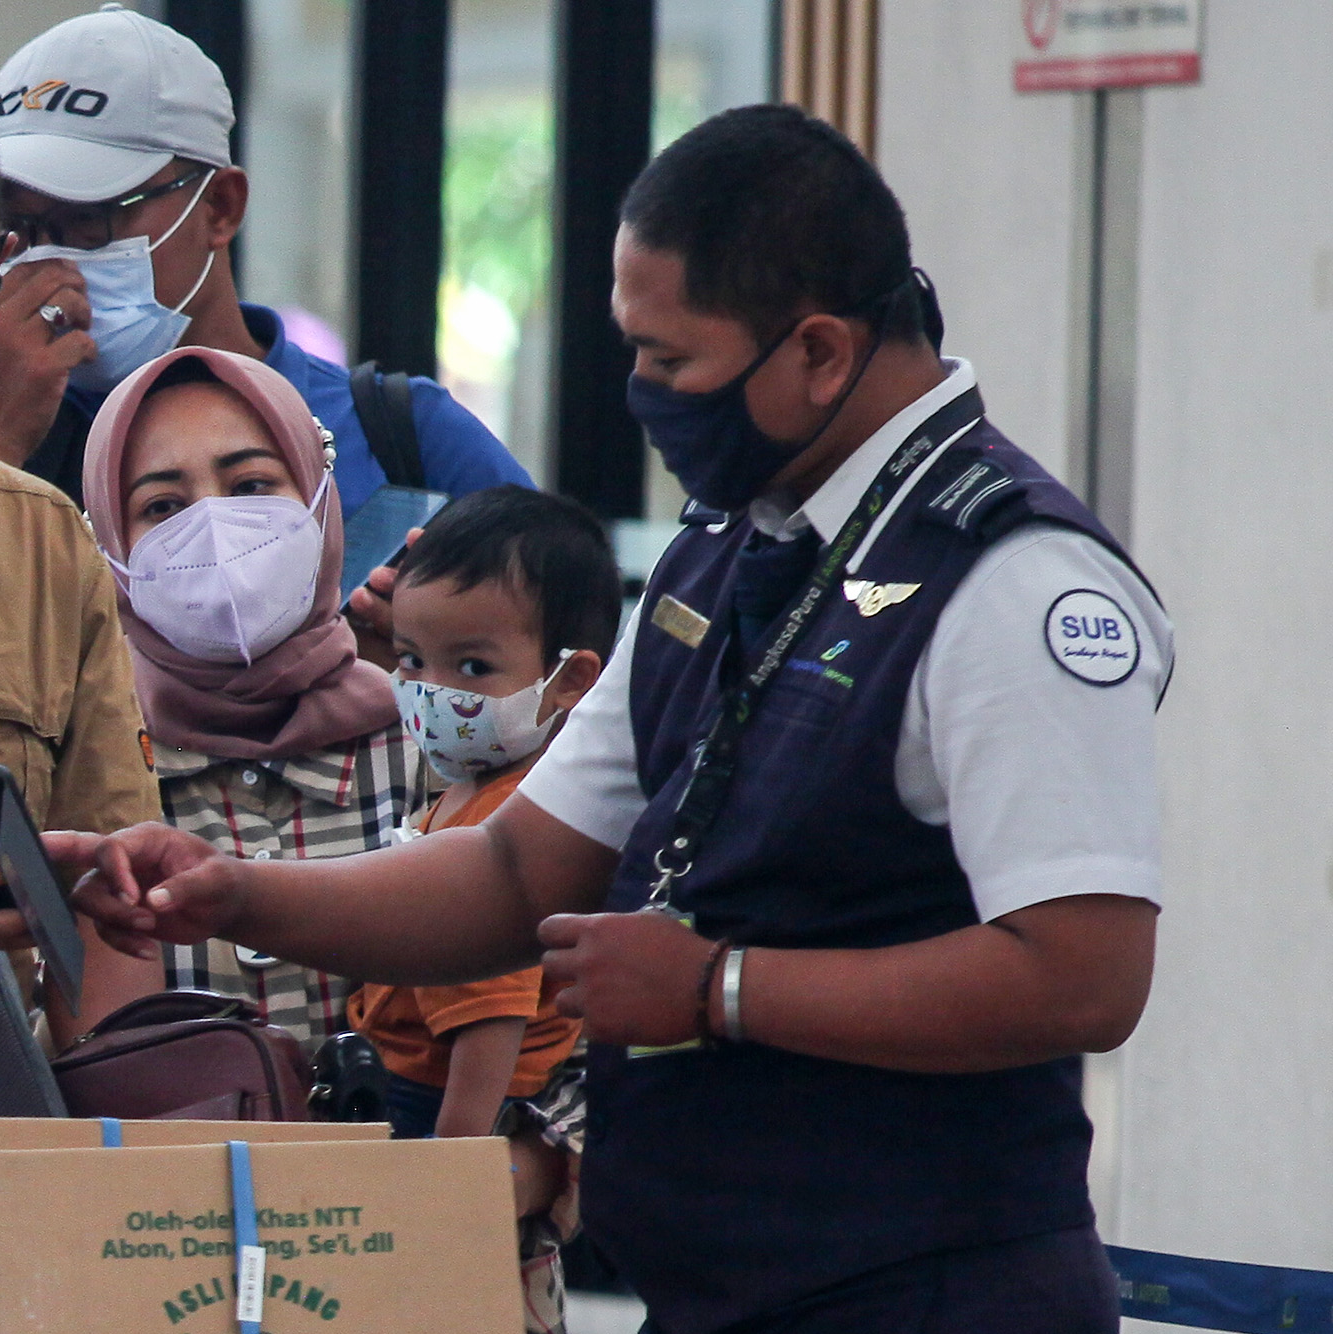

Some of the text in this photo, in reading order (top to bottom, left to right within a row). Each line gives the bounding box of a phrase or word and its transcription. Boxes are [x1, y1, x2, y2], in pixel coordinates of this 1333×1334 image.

[1061, 615, 1121, 641] SUB
[315, 1206, 363, 1228] NTT
[102, 1238, 175, 1260] Abon,
[181, 1237, 301, 1260] Denng,
[363, 1231, 394, 1254] dll
[162, 1276, 224, 1325] ASLI
[231, 1272, 341, 1321] PANG
